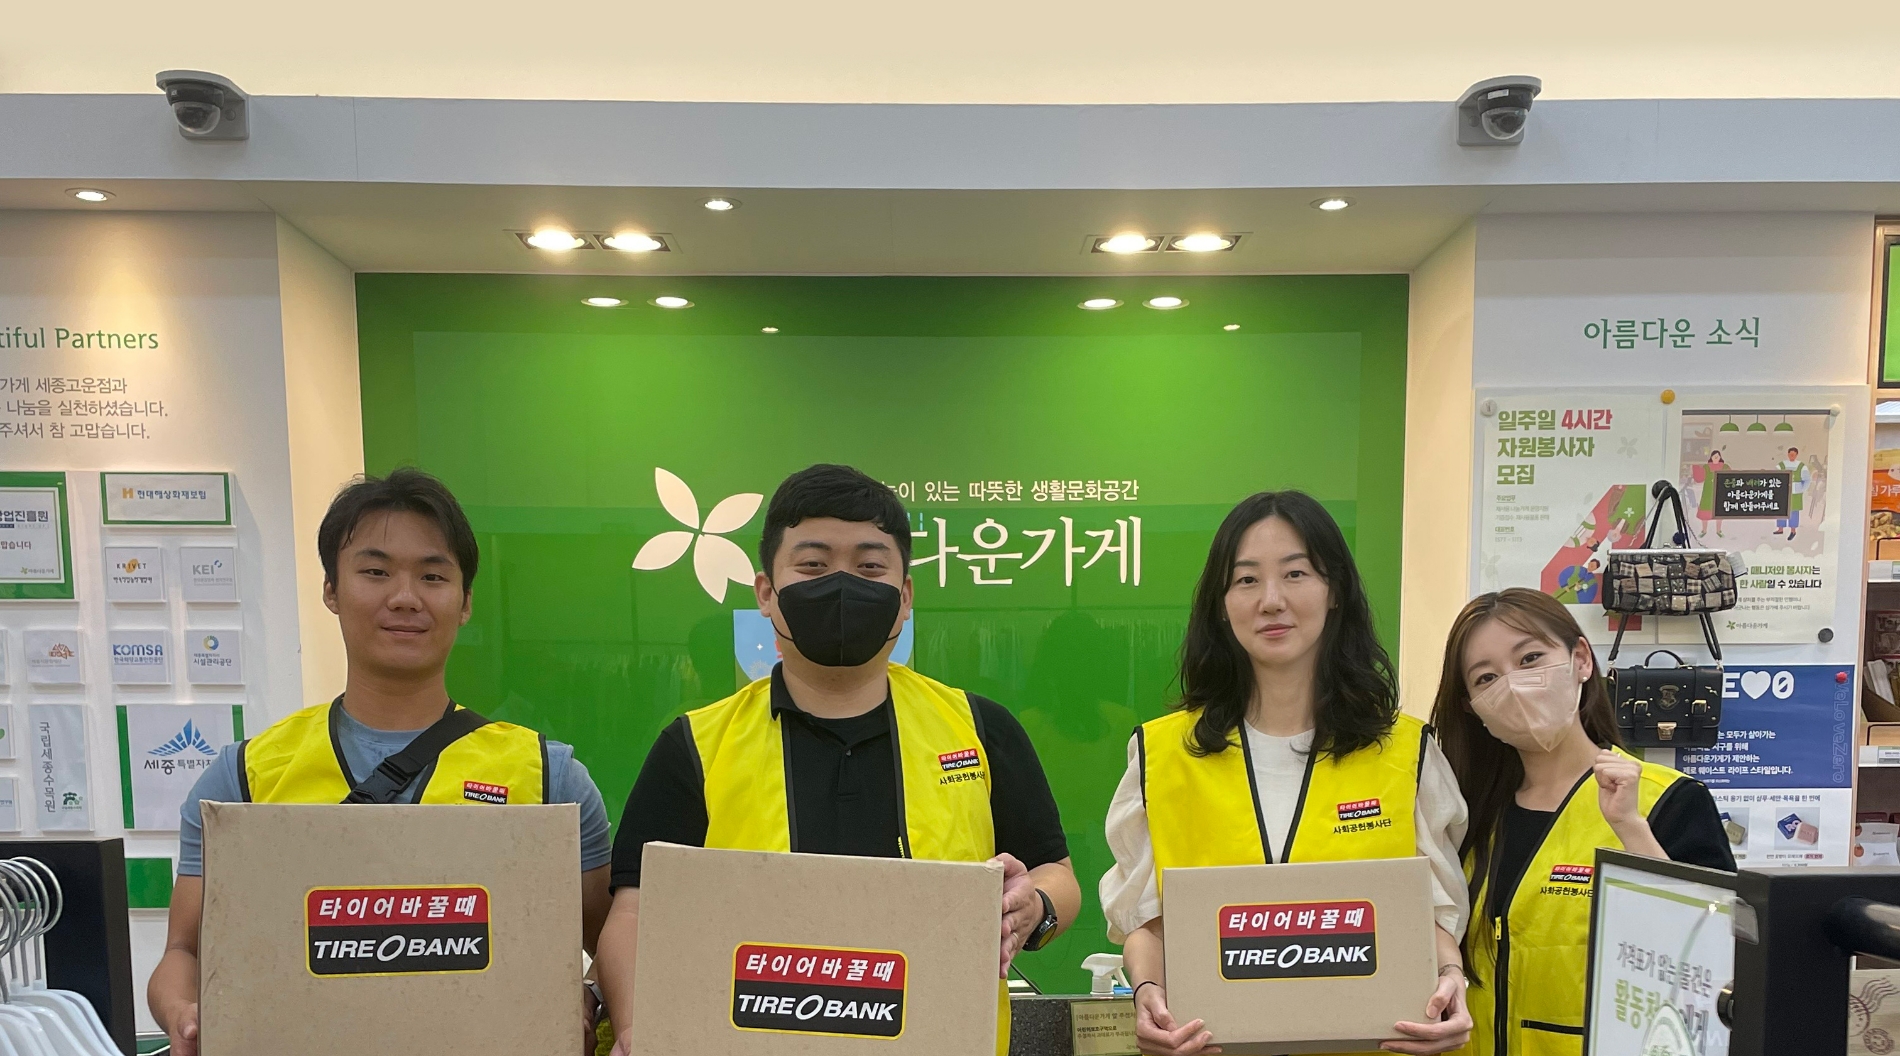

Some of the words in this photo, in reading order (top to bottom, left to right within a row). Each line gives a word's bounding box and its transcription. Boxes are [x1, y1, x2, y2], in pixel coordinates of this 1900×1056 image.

[55, 328, 159, 349] Partners
[1584, 318, 1696, 349] 아름다운
[1706, 317, 1760, 348] 소식
[36, 377, 128, 394] 세종고운점과
[7, 399, 52, 416] 나눔을
[58, 400, 168, 417] 실천하셨습니다.
[1498, 410, 1556, 431] 일주일
[1561, 409, 1613, 430] 4시간
[50, 422, 65, 438] 참
[70, 422, 150, 439] 고맙습니다.
[1497, 436, 1595, 457] 자원봉사자
[1497, 464, 1535, 485] 모집
[925, 481, 960, 501] 있는
[969, 481, 1023, 501] 따뜻한
[1031, 480, 1139, 501] 생활문화공간
[1769, 478, 1782, 488] 있는
[0, 541, 32, 549] 맙습니다
[192, 565, 214, 575] KEI
[1777, 580, 1786, 588] 수
[1788, 579, 1822, 588] 있습니다
[112, 644, 163, 656] KOMSA
[193, 659, 232, 667] 시설관리공단
[1726, 731, 1747, 739] 모두가
[40, 721, 56, 812] 국립세종수목원
[144, 759, 176, 775] 세종
[940, 771, 985, 785] 사회공헌봉사
[1333, 818, 1392, 834] 사회공헌봉사단
